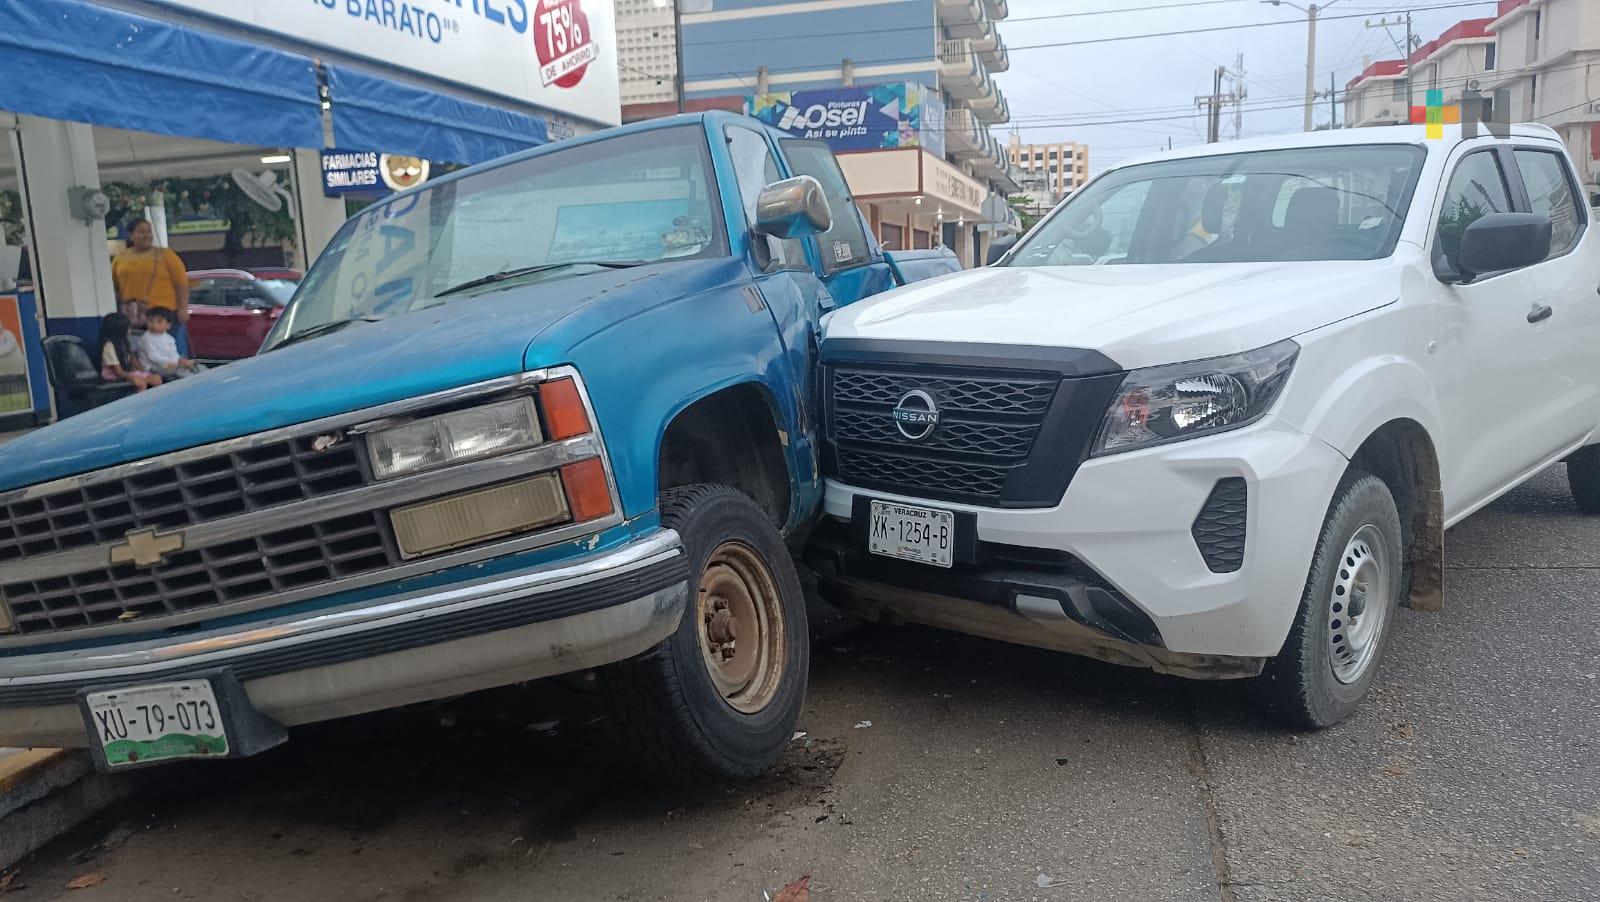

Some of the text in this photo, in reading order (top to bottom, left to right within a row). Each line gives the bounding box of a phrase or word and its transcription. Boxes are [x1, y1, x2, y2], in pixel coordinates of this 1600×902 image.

[540, 3, 583, 58] 75%
[546, 50, 591, 80] DE AHORRO
[804, 100, 867, 129] Osel
[322, 152, 377, 170] FARMACIAS
[893, 410, 937, 422] NISSAN
[893, 507, 927, 519] VERACRUZ
[872, 514, 949, 550] XK-1254-B
[96, 700, 216, 742] XU-79-073
